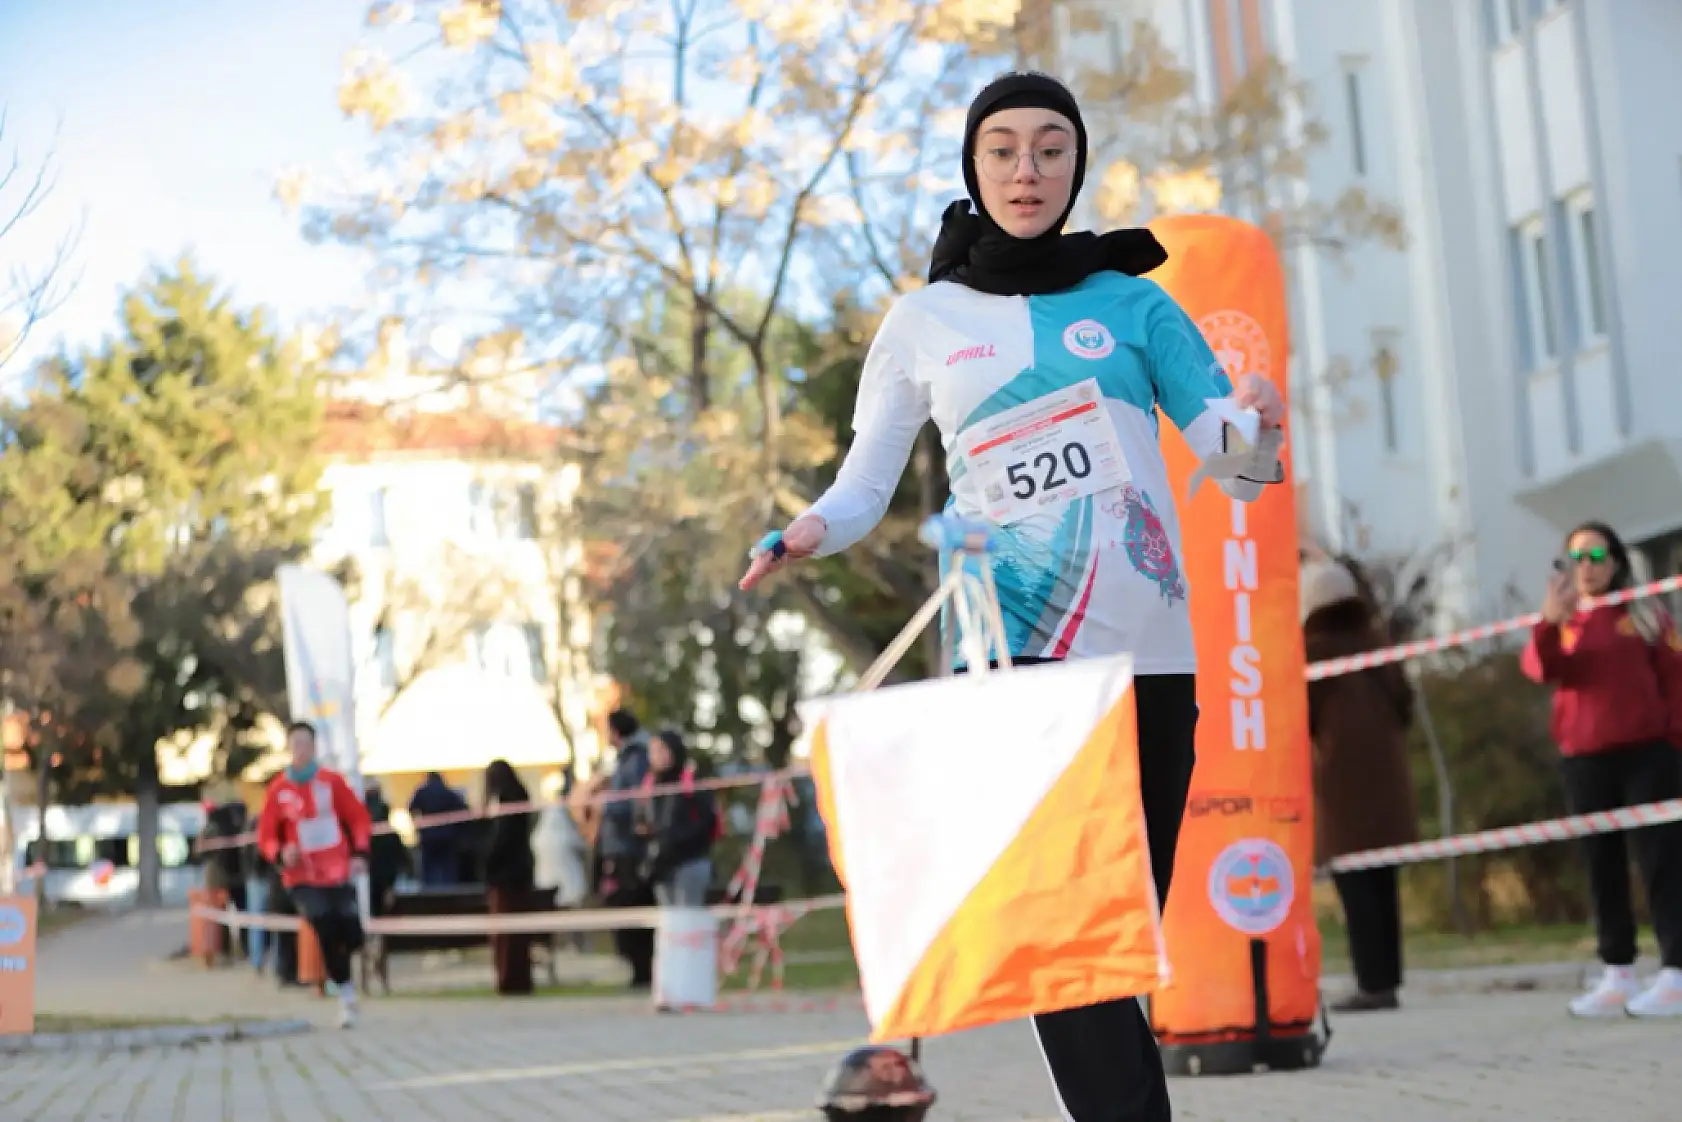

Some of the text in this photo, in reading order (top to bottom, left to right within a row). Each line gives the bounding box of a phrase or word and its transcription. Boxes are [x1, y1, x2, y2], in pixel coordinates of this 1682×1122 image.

[946, 344, 996, 366] UPHILL
[1006, 442, 1091, 499] 520
[1223, 498, 1266, 751] INISH
